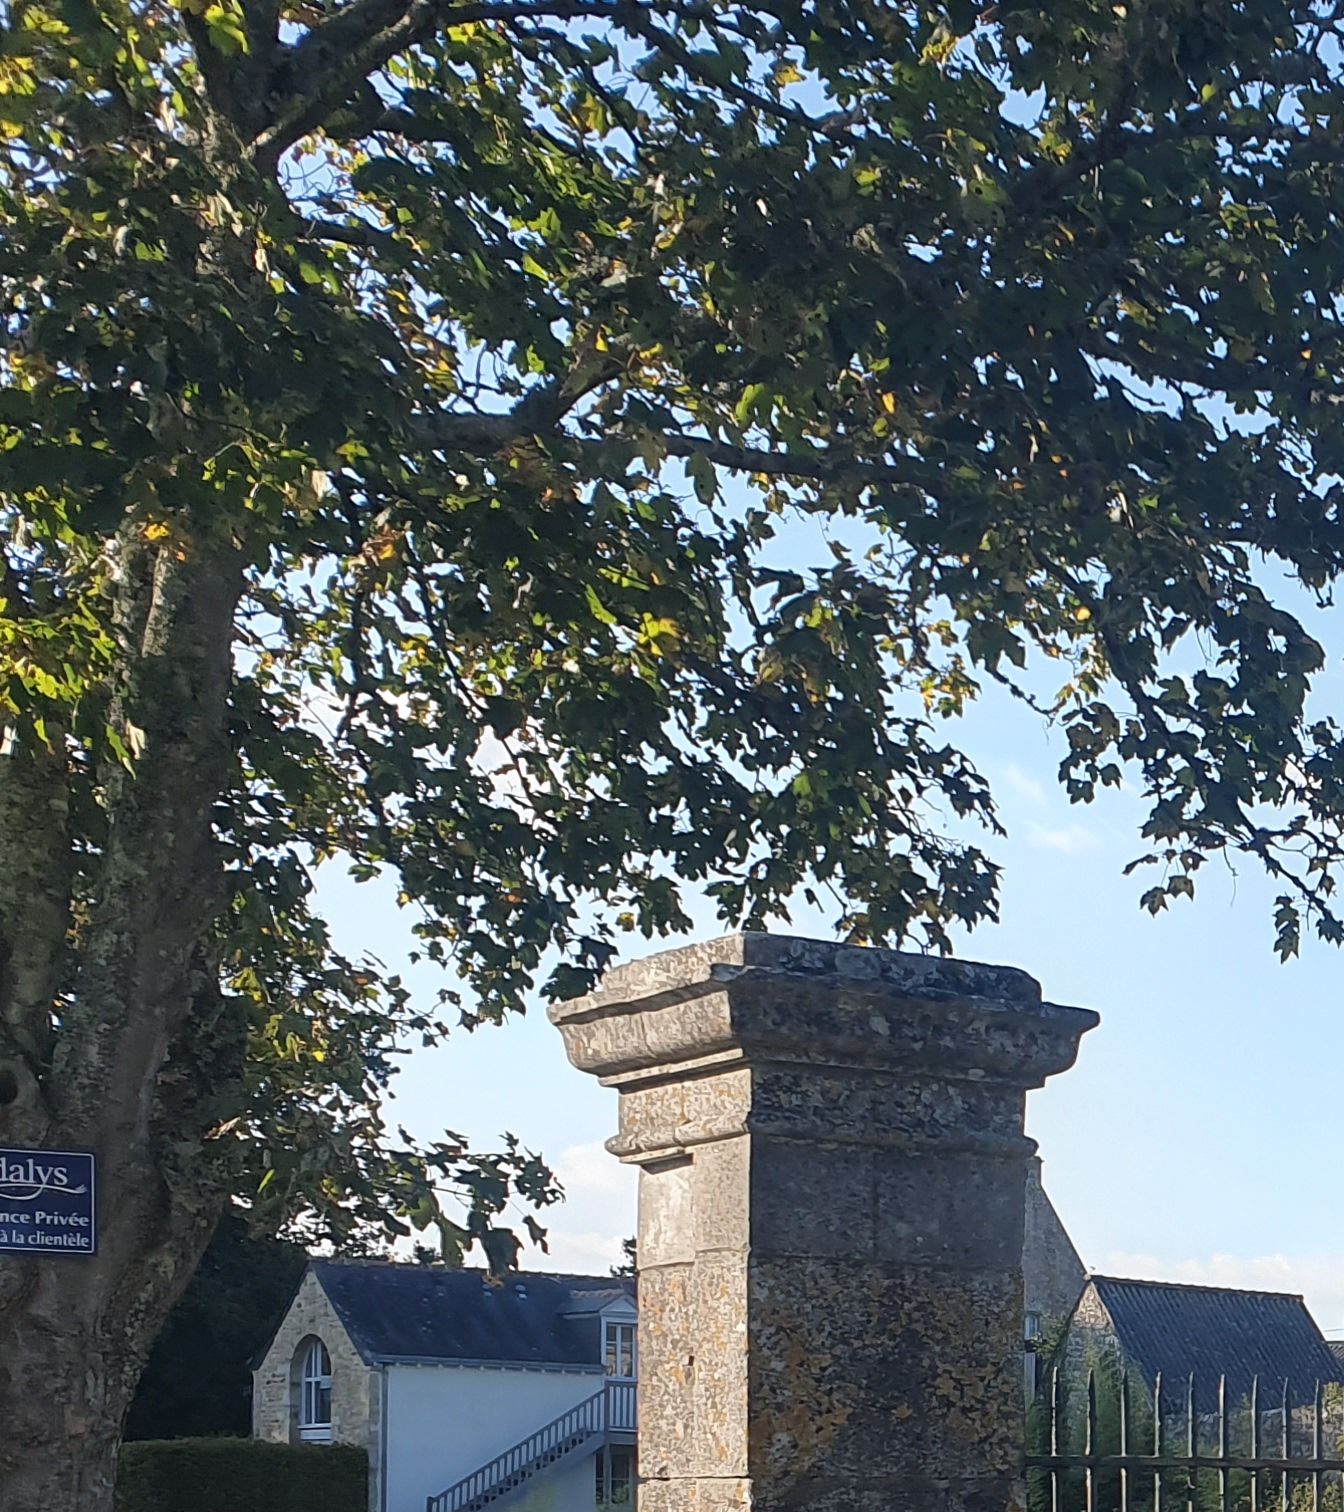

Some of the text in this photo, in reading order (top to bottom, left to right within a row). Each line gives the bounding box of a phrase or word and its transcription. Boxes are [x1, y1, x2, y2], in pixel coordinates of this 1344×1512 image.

[34, 1210, 90, 1227] Privée
[12, 1229, 25, 1244] la
[27, 1230, 90, 1248] clientèle
